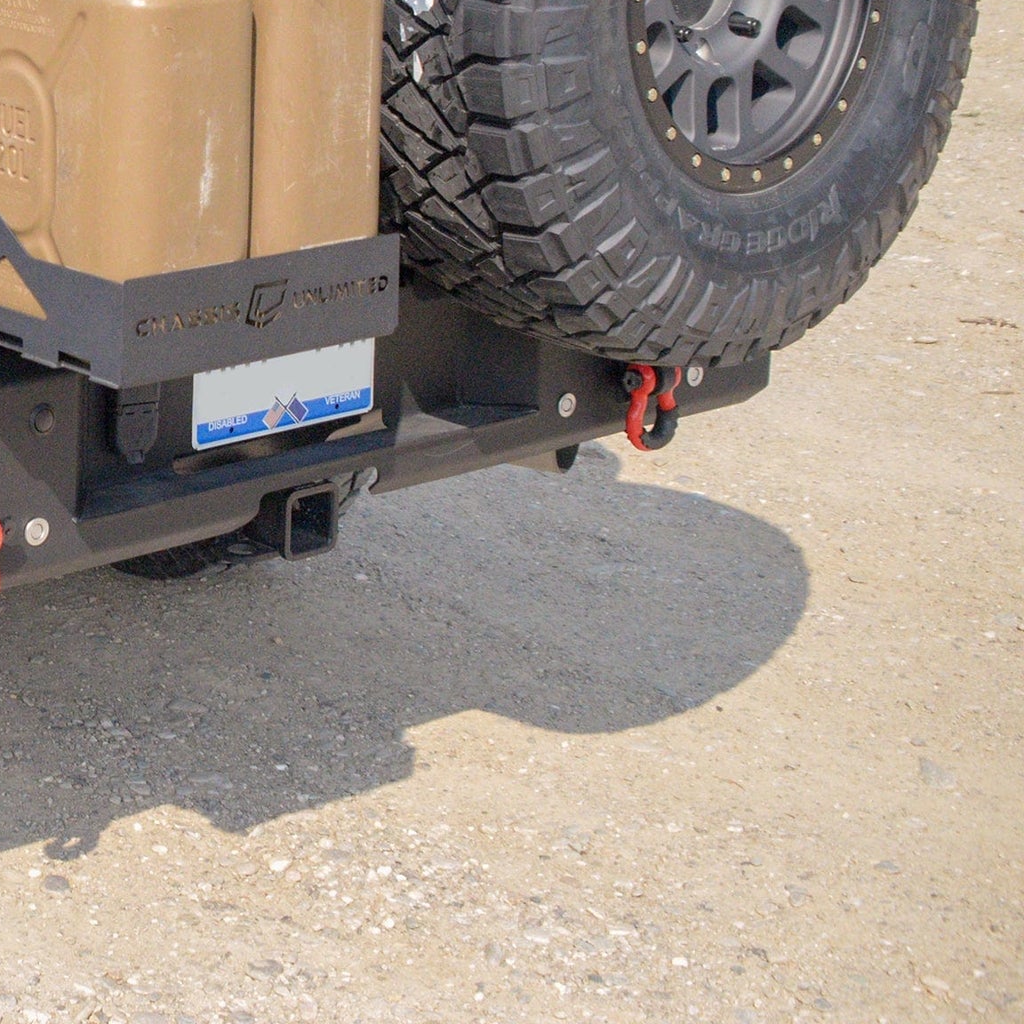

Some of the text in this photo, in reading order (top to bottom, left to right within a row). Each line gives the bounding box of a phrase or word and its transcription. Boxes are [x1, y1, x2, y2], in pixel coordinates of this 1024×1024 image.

[135, 274, 389, 337] CHASSIS UNLIMITED
[207, 389, 361, 432] DISABLED VETERAN
